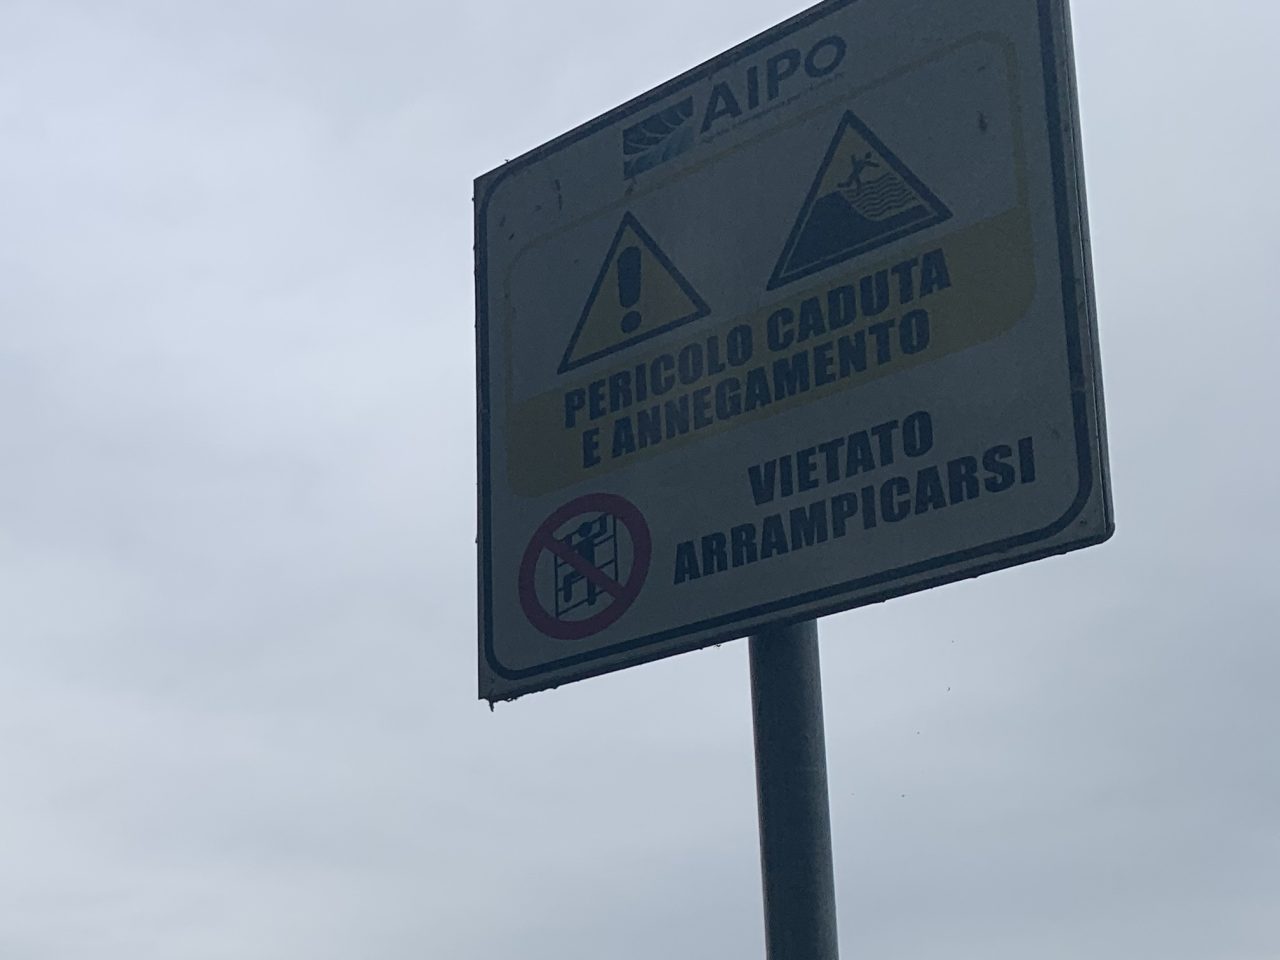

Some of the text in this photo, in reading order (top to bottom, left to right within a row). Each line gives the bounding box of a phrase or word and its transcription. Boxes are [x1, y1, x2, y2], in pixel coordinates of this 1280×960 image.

[700, 35, 847, 134] AIPO
[564, 249, 952, 428] PERICOLO CADUTA
[582, 309, 930, 468] E ANNEGAMENTO
[673, 438, 1035, 585] ARRAMPICARSI
[748, 410, 934, 505] VIETATO
